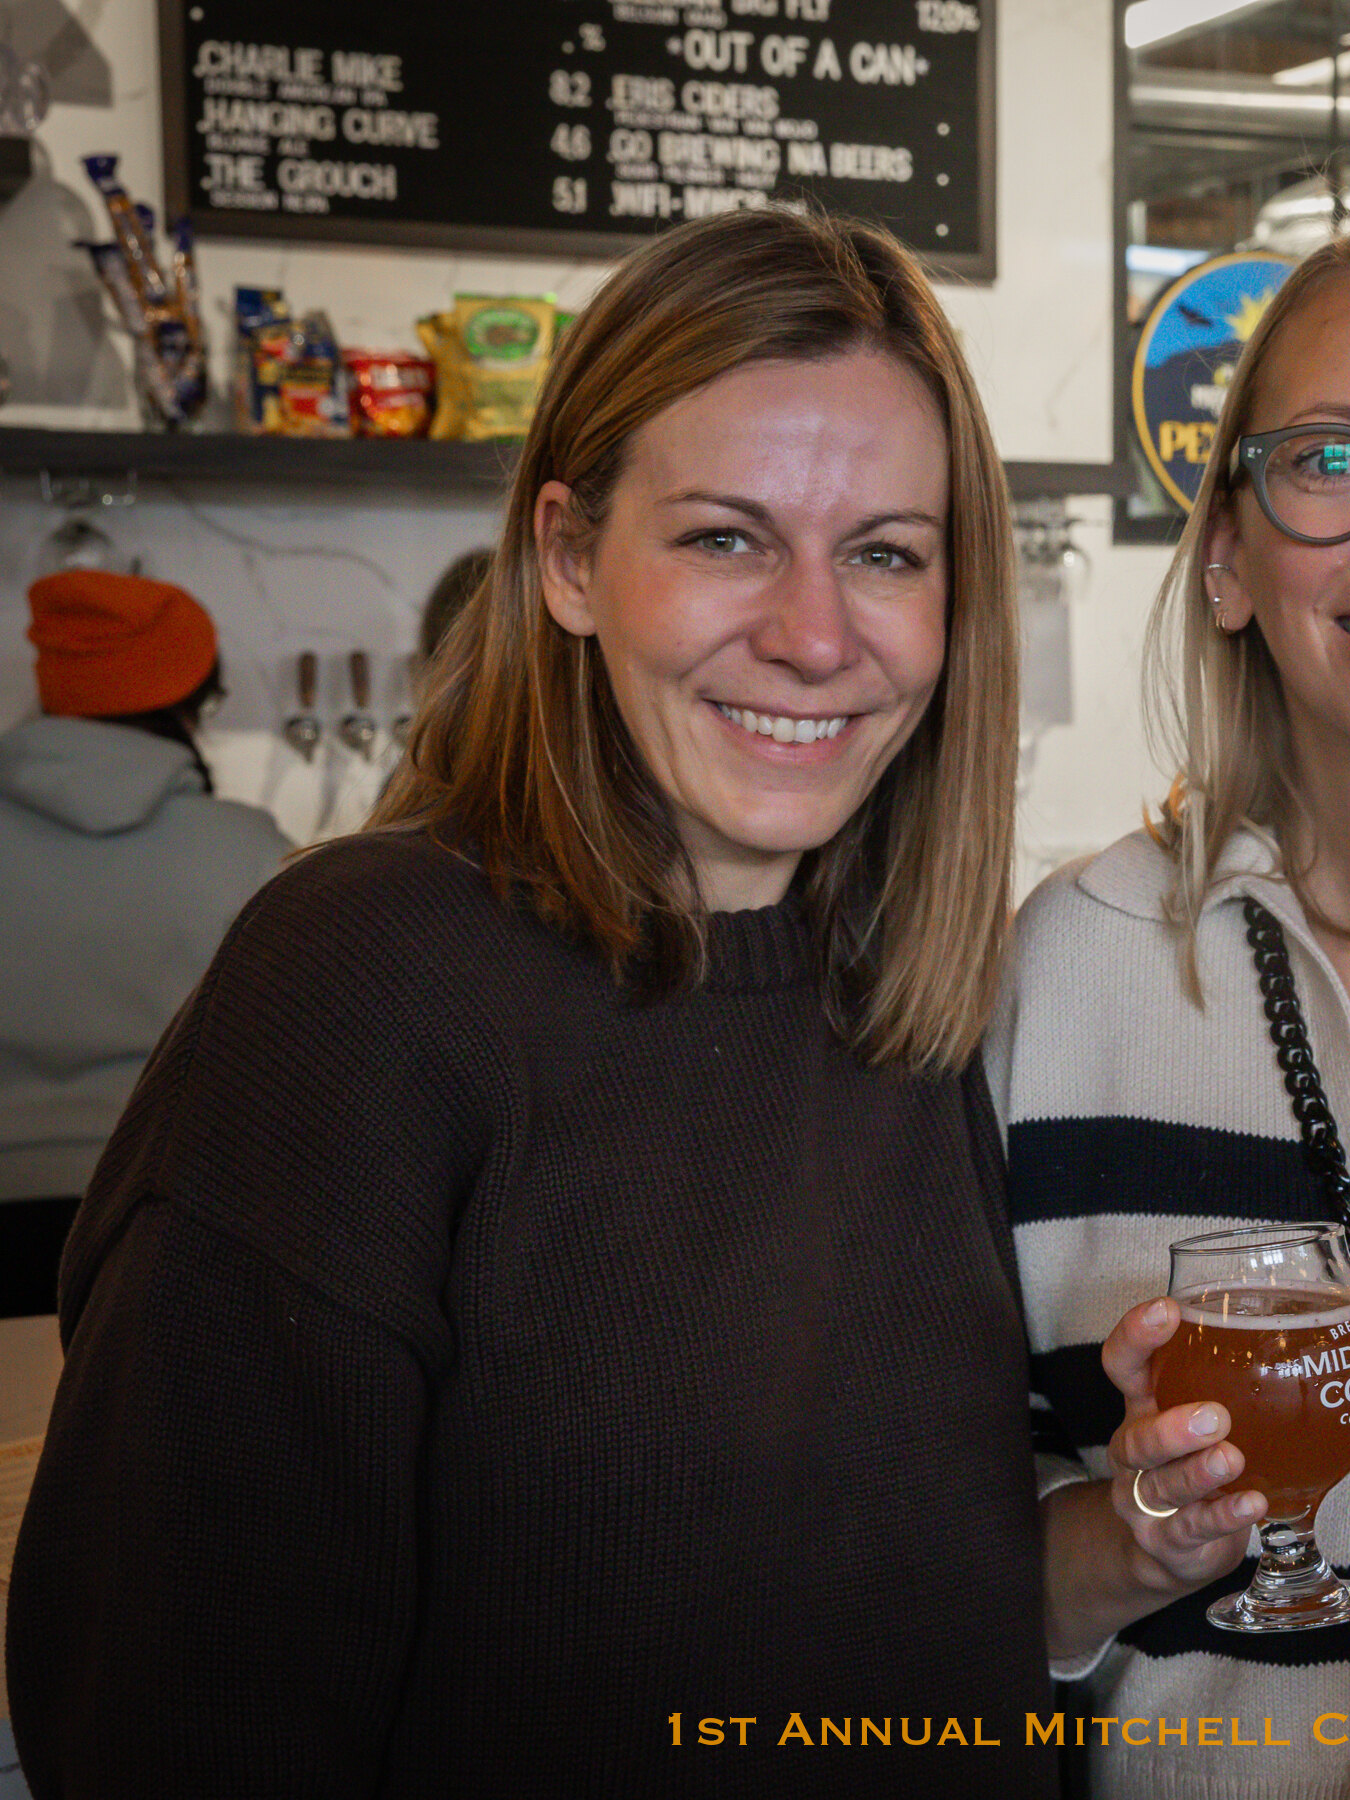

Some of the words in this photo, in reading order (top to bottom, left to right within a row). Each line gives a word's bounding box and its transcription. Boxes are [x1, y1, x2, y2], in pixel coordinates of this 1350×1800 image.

[331, 50, 402, 92] MIKE
[759, 34, 810, 79] OF
[812, 37, 843, 82] A
[680, 79, 780, 121] CIDERS
[202, 97, 336, 142] HANGING
[341, 106, 440, 150] CURVE
[203, 152, 267, 193] THE
[276, 158, 398, 202] GROUCH
[787, 141, 827, 177] NA
[829, 143, 914, 183] BEERS
